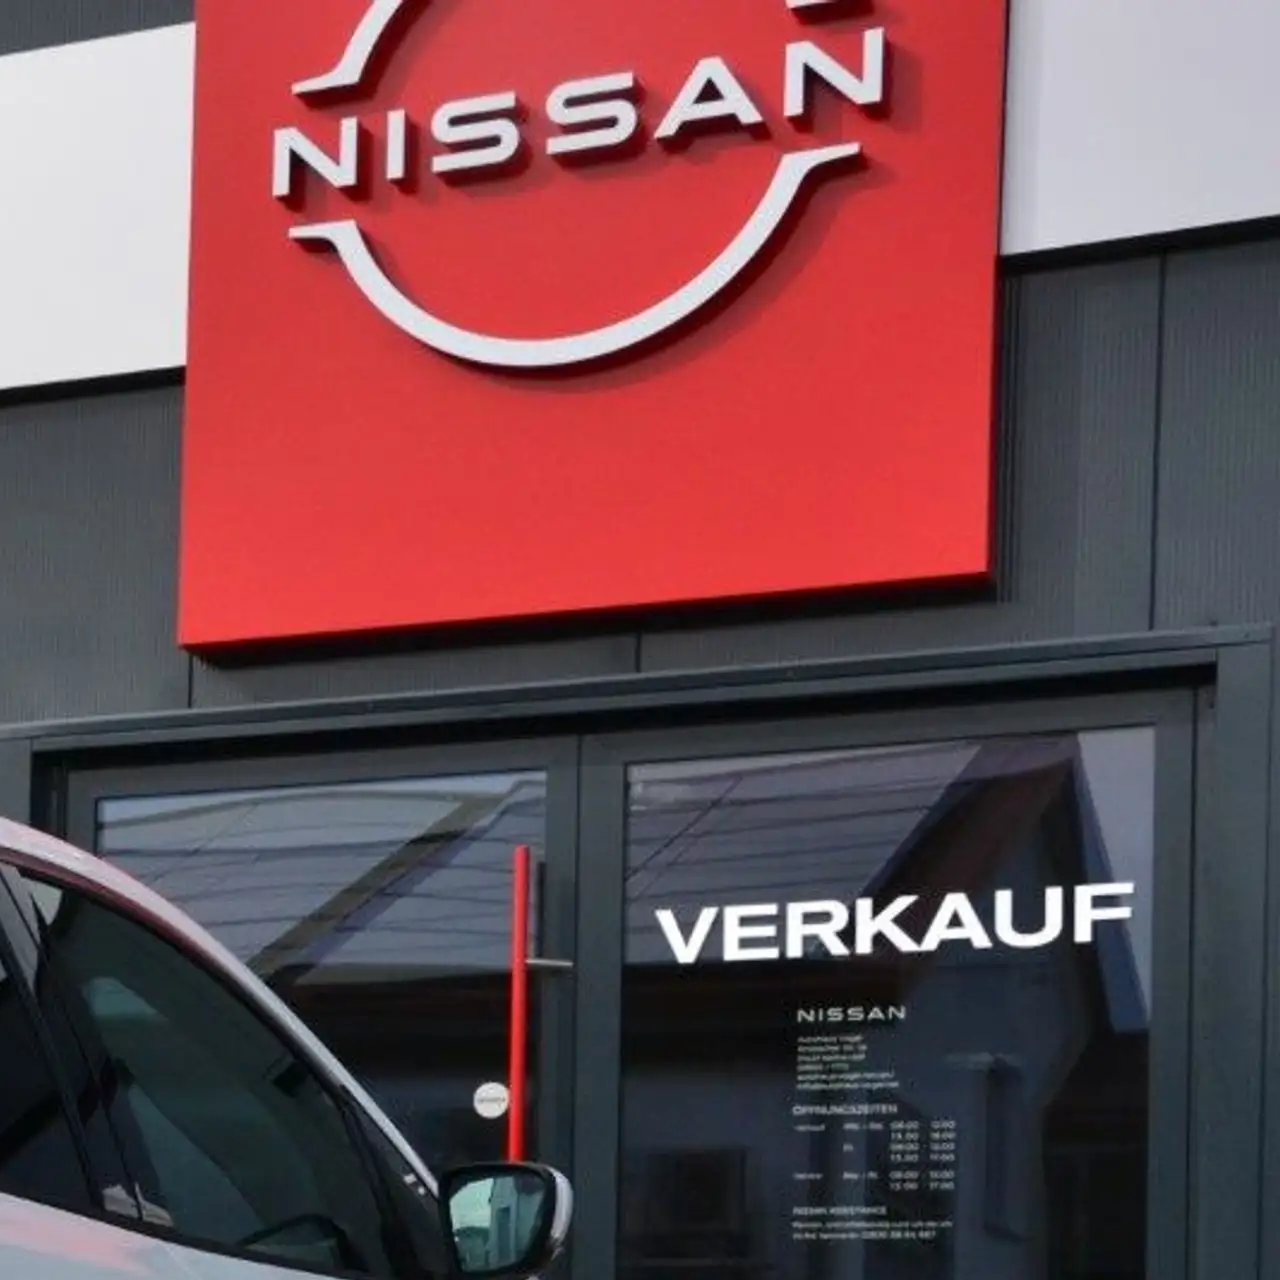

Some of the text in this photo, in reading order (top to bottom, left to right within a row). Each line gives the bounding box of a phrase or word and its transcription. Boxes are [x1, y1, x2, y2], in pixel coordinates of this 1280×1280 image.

[272, 27, 886, 199] NISSAN
[655, 882, 1135, 964] VERKAUF
[797, 1005, 906, 1022] NISSAN
